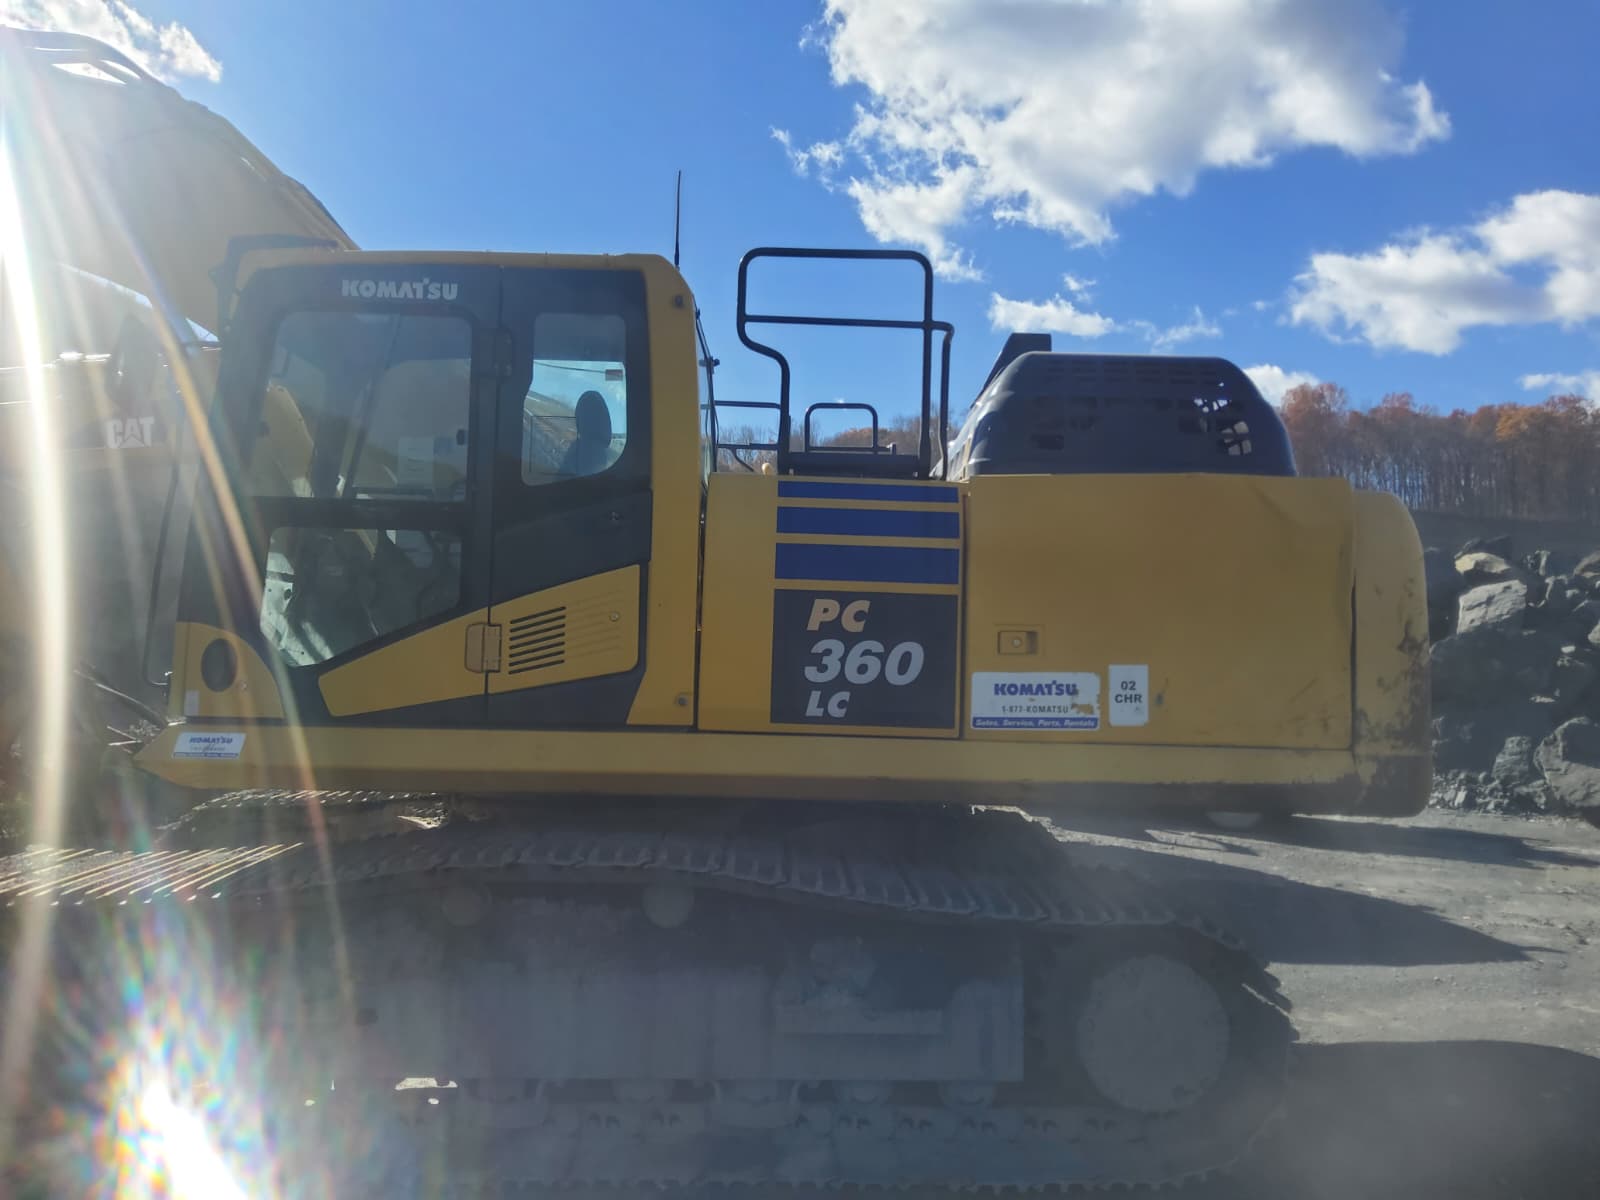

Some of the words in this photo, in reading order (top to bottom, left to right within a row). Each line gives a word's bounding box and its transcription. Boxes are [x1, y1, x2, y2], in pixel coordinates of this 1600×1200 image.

[341, 277, 459, 300] KOMATSU
[106, 416, 155, 449] CAT
[806, 598, 871, 633] PC
[804, 638, 925, 686] 360
[993, 680, 1079, 696] KOMATSU
[1120, 680, 1136, 691] 02
[805, 690, 851, 718] LC
[1114, 693, 1142, 704] CHR
